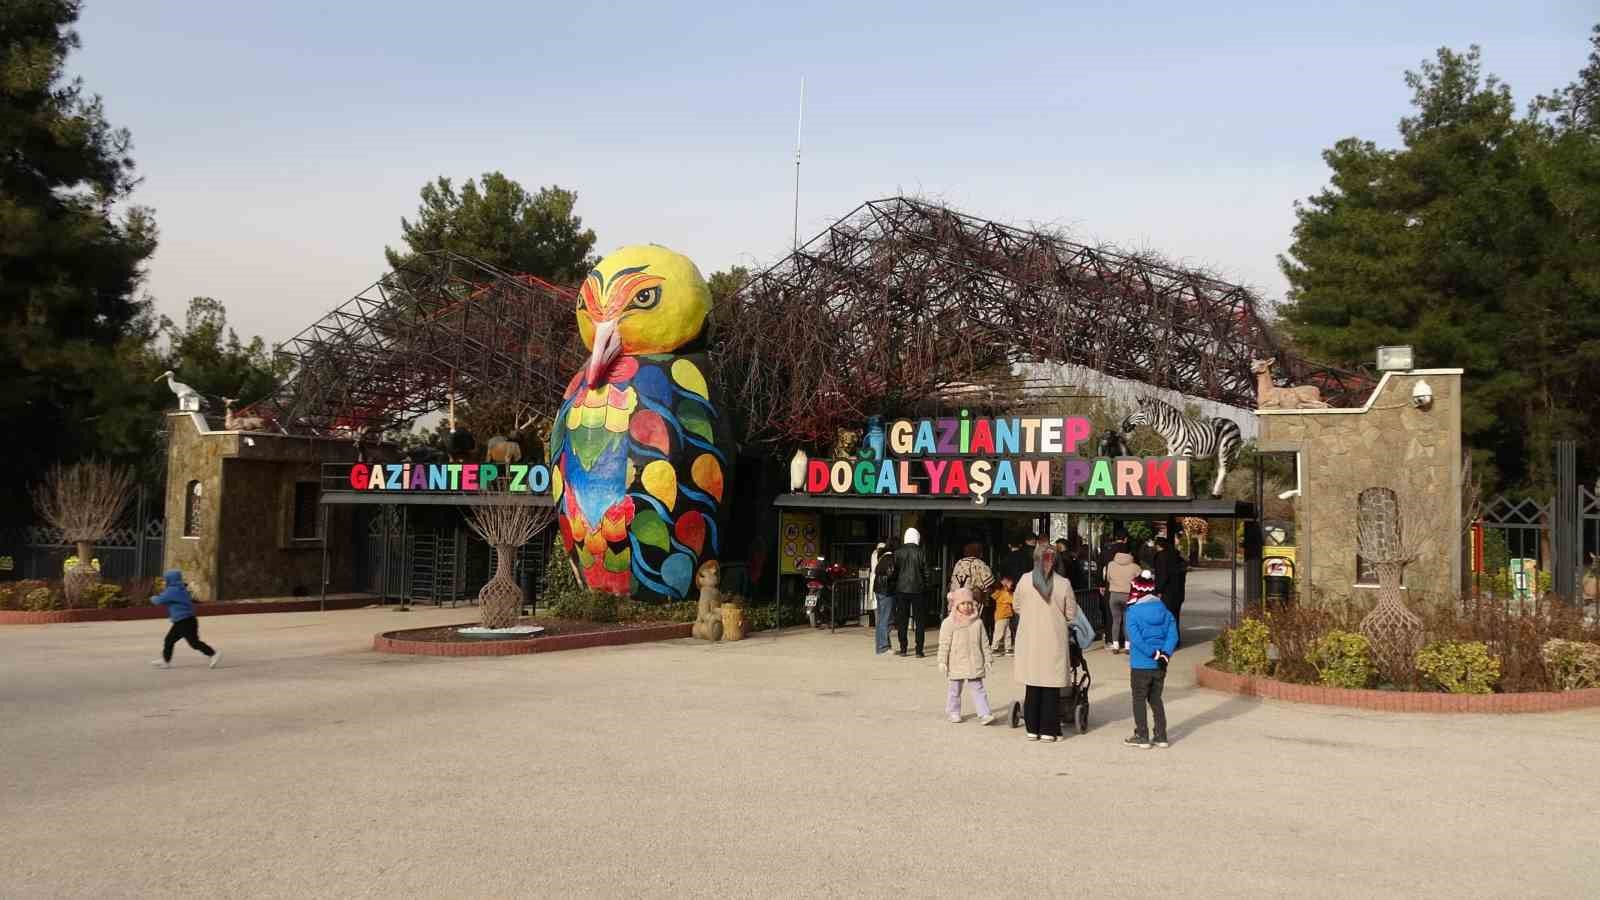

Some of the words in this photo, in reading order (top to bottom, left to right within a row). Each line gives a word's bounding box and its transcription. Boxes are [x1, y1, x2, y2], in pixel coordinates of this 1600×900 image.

[891, 410, 1090, 454] GAZİANTEP
[808, 450, 919, 495] DOĞAL
[926, 460, 1051, 504] YAŞAM
[1064, 460, 1189, 497] PARKI
